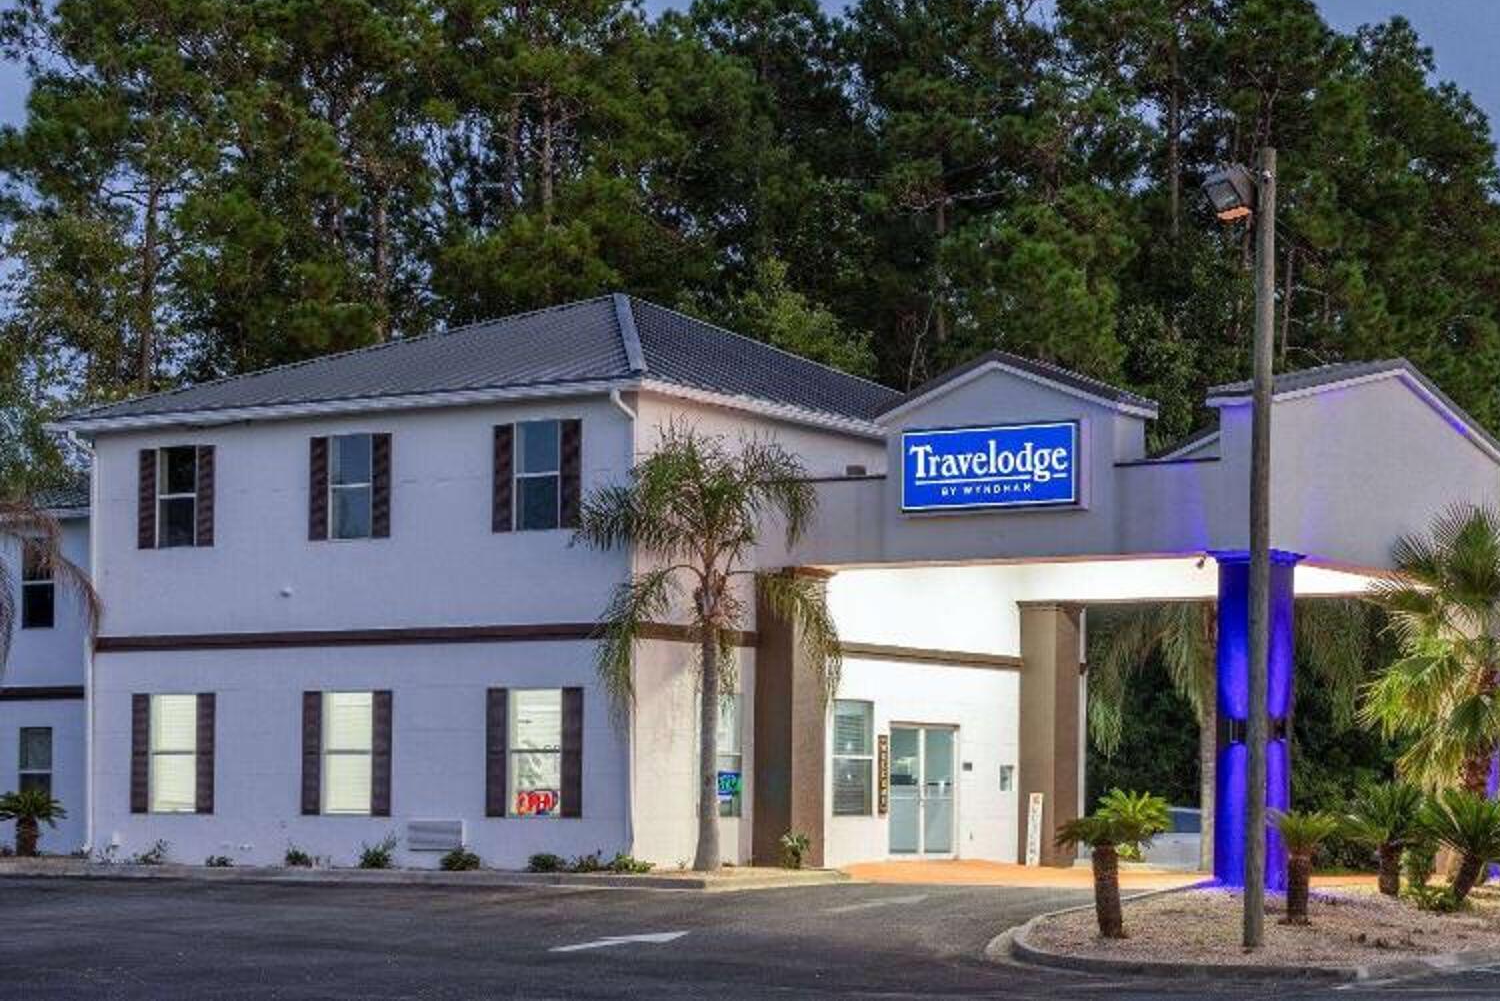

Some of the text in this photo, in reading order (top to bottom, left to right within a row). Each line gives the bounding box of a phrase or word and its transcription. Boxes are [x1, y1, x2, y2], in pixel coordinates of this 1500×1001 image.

[909, 439, 1068, 482] Travelodge
[941, 482, 1032, 496] BY WYNDHAM
